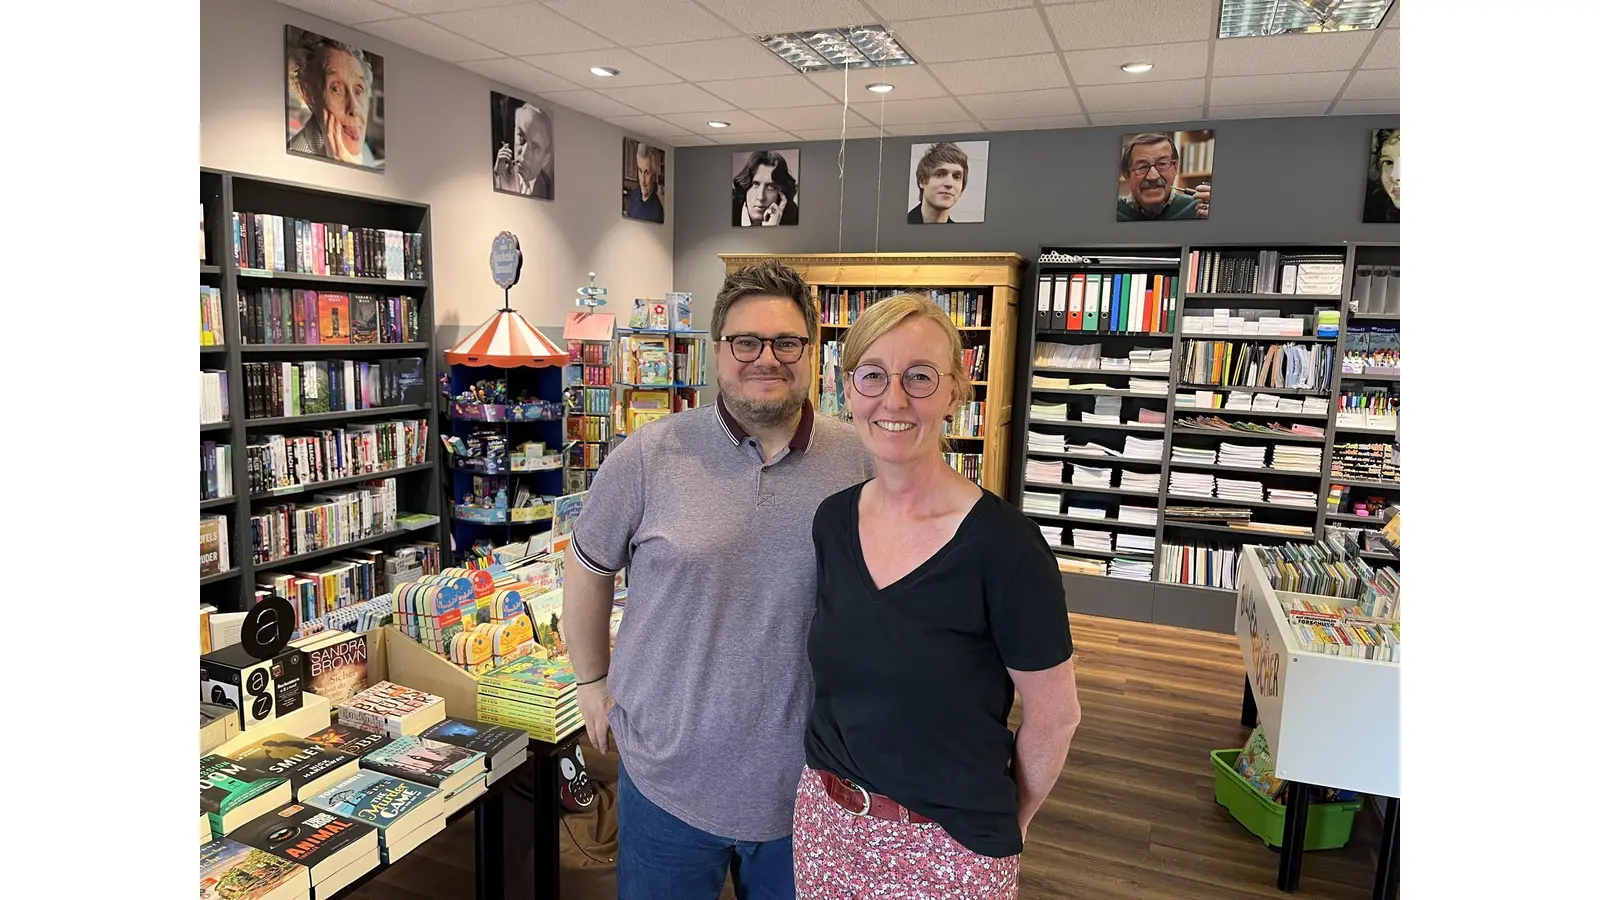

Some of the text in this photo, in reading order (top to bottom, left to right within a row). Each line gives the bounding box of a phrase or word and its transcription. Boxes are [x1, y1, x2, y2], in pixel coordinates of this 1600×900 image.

[256, 608, 280, 646] a
[311, 638, 366, 664] SANDRA
[312, 648, 367, 677] BROWN
[252, 672, 264, 691] a
[329, 670, 357, 684] Sicher
[269, 744, 326, 774] SMILEY
[318, 785, 338, 799] TOM
[358, 782, 410, 820] Murder
[371, 791, 388, 804] THE
[380, 790, 419, 818] GAME
[285, 821, 354, 859] ANIMAL
